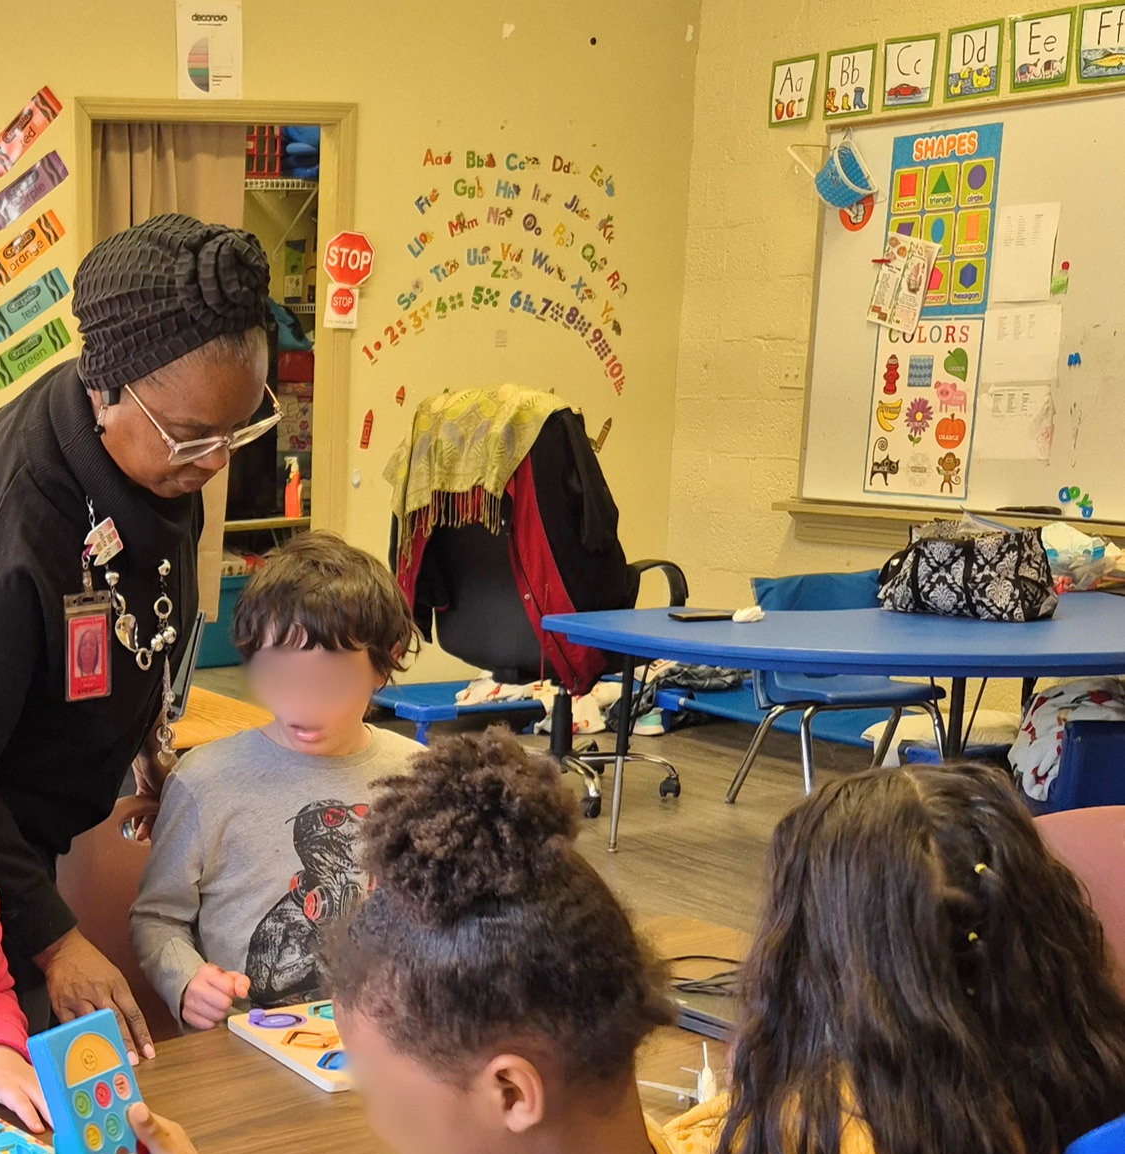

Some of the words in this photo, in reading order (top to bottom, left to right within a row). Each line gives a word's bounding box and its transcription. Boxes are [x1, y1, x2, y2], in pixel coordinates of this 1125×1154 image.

[1097, 9, 1125, 46] Ff
[962, 30, 988, 66] Dd
[1028, 21, 1057, 56] Ee
[896, 45, 921, 76] Cc
[779, 66, 803, 95] Aa
[840, 55, 860, 87] Bb
[913, 130, 978, 161] SHAPES
[422, 148, 443, 167] Aa
[465, 150, 484, 169] Bb
[505, 153, 526, 171] Cc
[551, 154, 571, 174] Dd
[588, 164, 604, 188] Ee
[453, 178, 476, 199] Gg
[495, 179, 515, 200] Hh
[966, 194, 984, 203] circle
[896, 200, 917, 210] square
[929, 195, 952, 205] triangle
[486, 206, 506, 227] Nn
[522, 213, 542, 236] Oo
[552, 222, 566, 246] Pp
[9, 239, 45, 272] orange
[466, 247, 486, 266] Uu
[500, 242, 517, 262] Vv
[958, 242, 984, 252] rectangle
[327, 246, 372, 271] STOP
[531, 247, 555, 276] Ww
[581, 243, 598, 273] Qq
[490, 260, 509, 279] Zz
[570, 275, 587, 304] Xx
[606, 270, 620, 291] Rr
[332, 296, 353, 308] STOP
[397, 292, 417, 311] Ss
[435, 296, 447, 314] 4
[472, 285, 485, 305] 5
[510, 290, 522, 309] 6
[953, 291, 980, 300] hexagon
[21, 301, 41, 321] teal
[539, 297, 553, 316] 7
[565, 306, 579, 325] 8
[600, 300, 614, 325] Yy
[408, 310, 422, 329] 3
[383, 326, 399, 345] 2
[589, 328, 603, 344] 9
[17, 347, 47, 374] green
[361, 345, 374, 361] 1
[605, 355, 623, 379] 10
